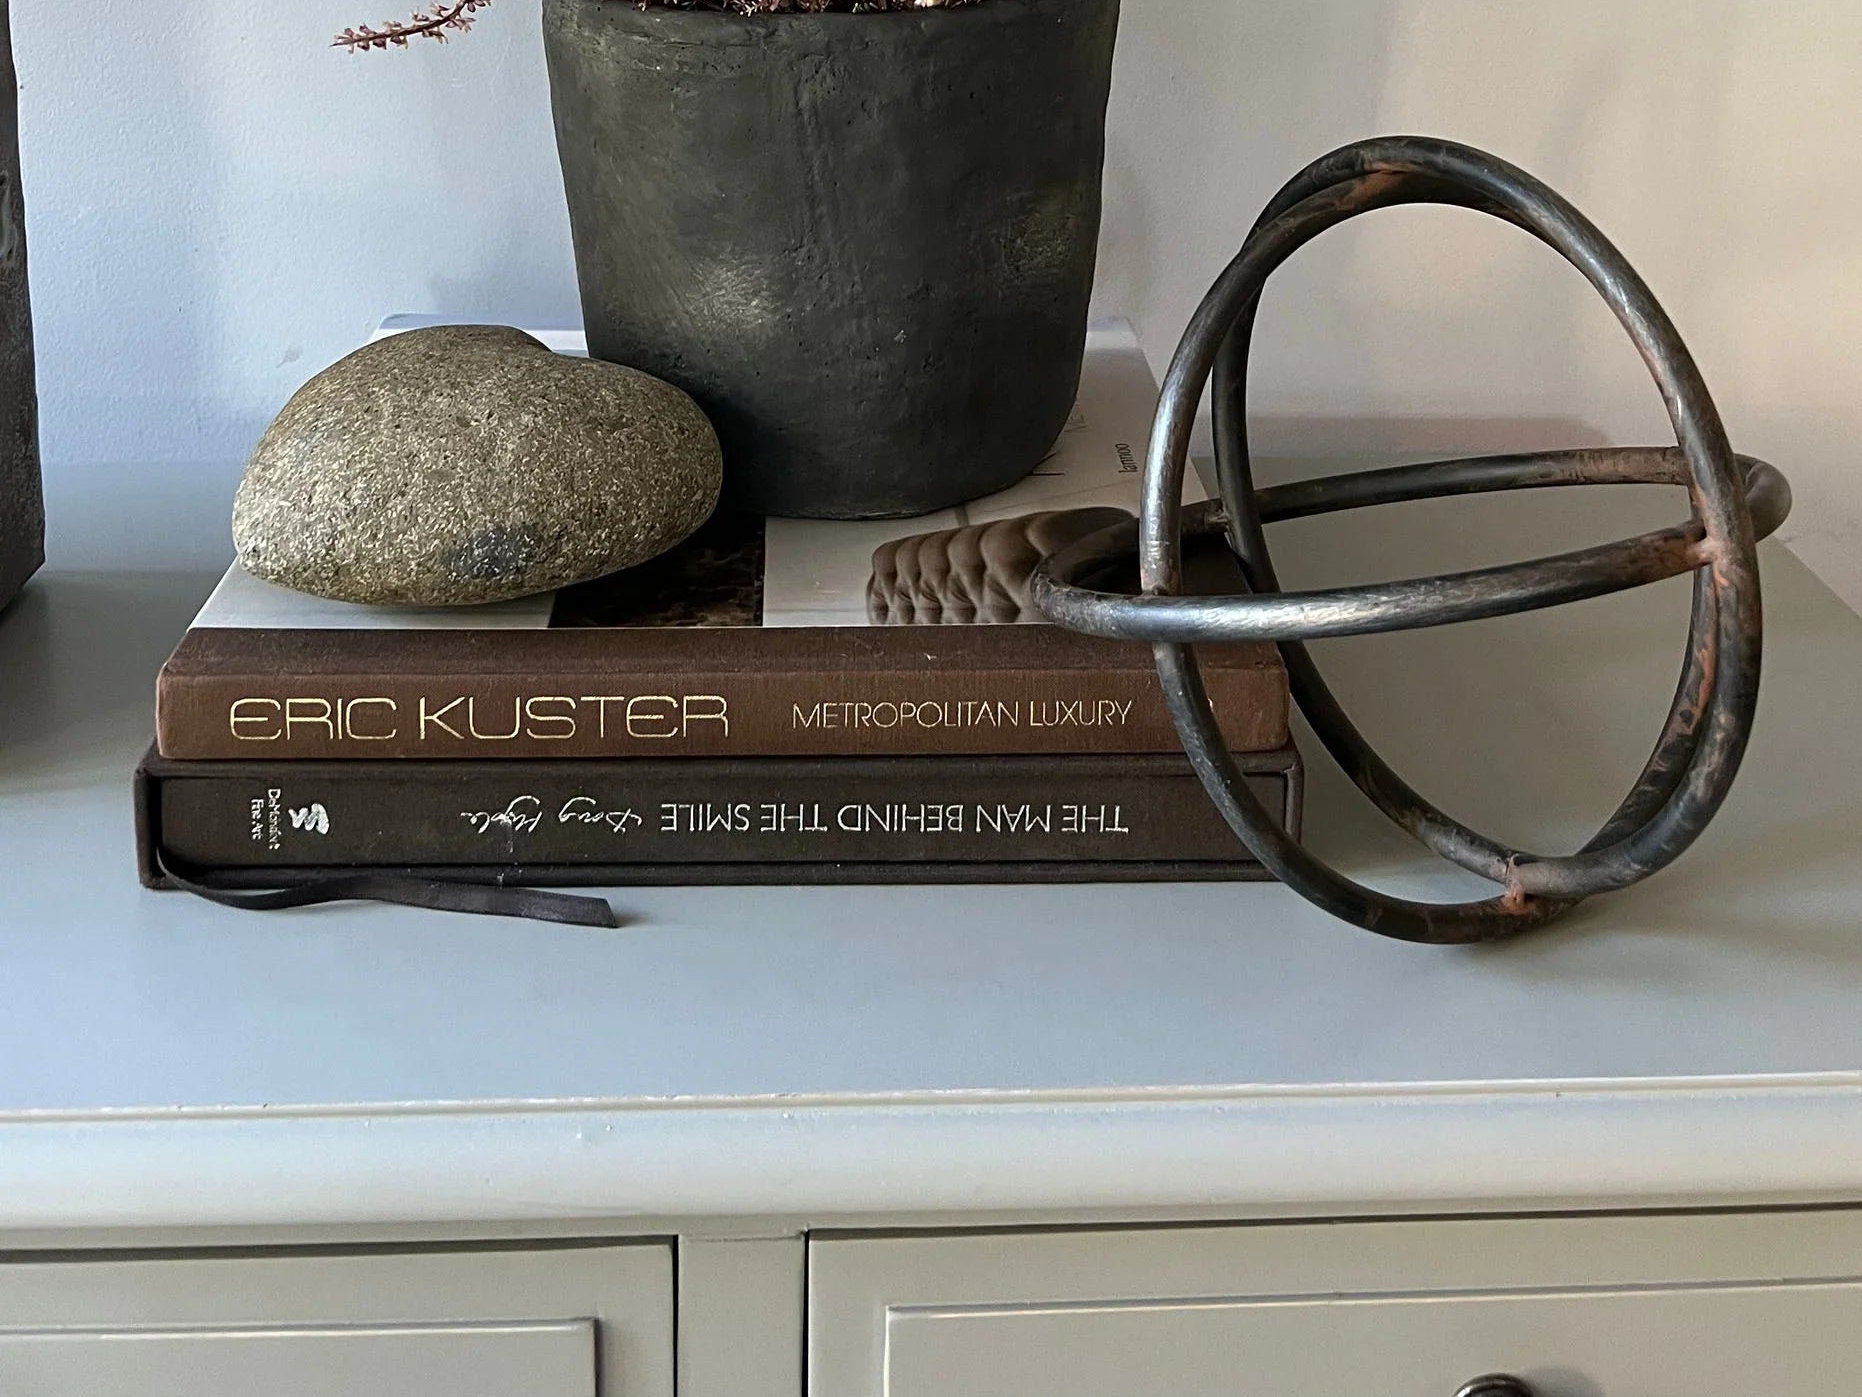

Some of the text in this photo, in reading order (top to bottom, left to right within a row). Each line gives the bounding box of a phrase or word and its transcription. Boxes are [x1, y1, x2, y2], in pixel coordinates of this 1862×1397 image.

[229, 695, 729, 740] ERIC KUSTER
[792, 699, 1133, 729] METROPOLITAN LUXURY
[659, 803, 1129, 834] THE MAN BEHIND THE SMILE
